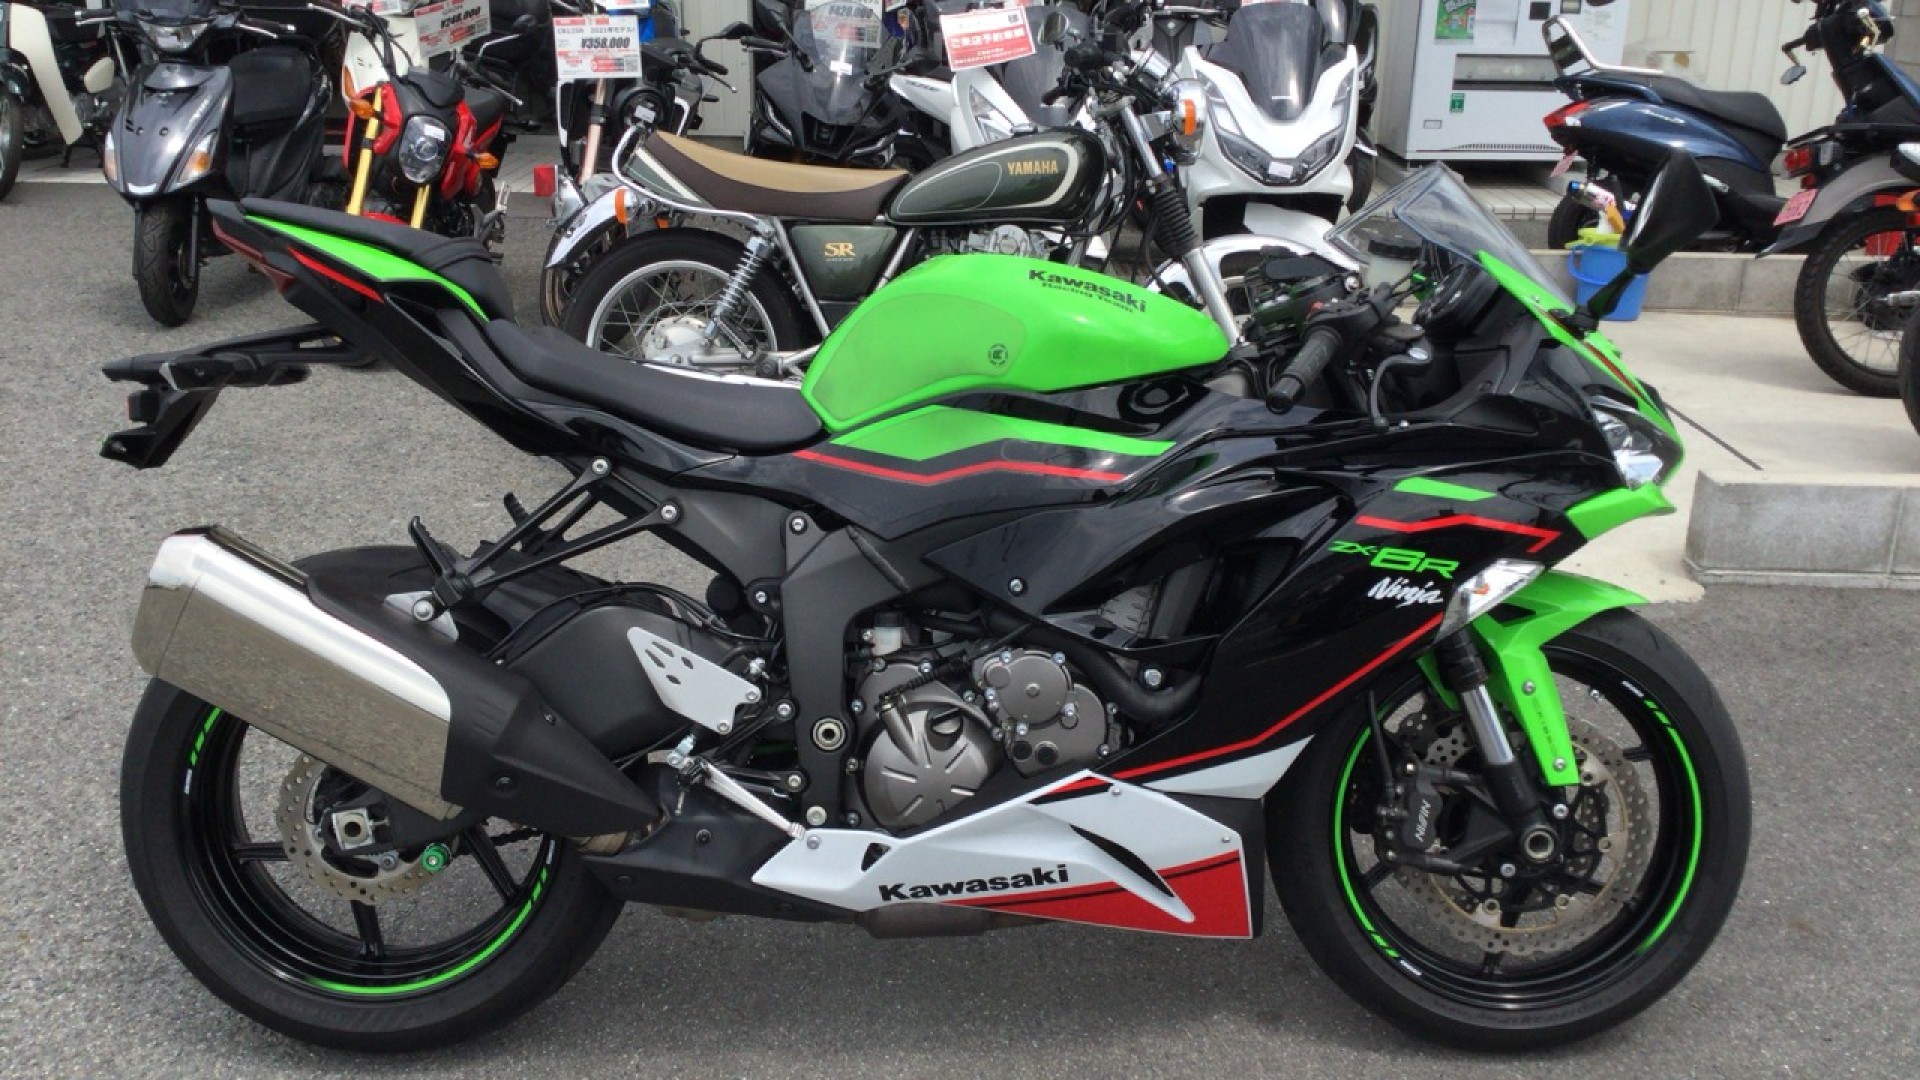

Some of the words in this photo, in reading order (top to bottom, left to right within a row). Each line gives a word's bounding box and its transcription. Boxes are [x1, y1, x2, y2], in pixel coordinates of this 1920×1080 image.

[1006, 159, 1059, 176] YAMAHA
[824, 242, 856, 257] SR
[1028, 269, 1146, 313] Kawasaki
[1328, 541, 1460, 579] ZX-6R
[1367, 576, 1444, 609] Ninja
[1415, 799, 1431, 842] NISSIN
[879, 864, 1069, 902] Kawasaki
